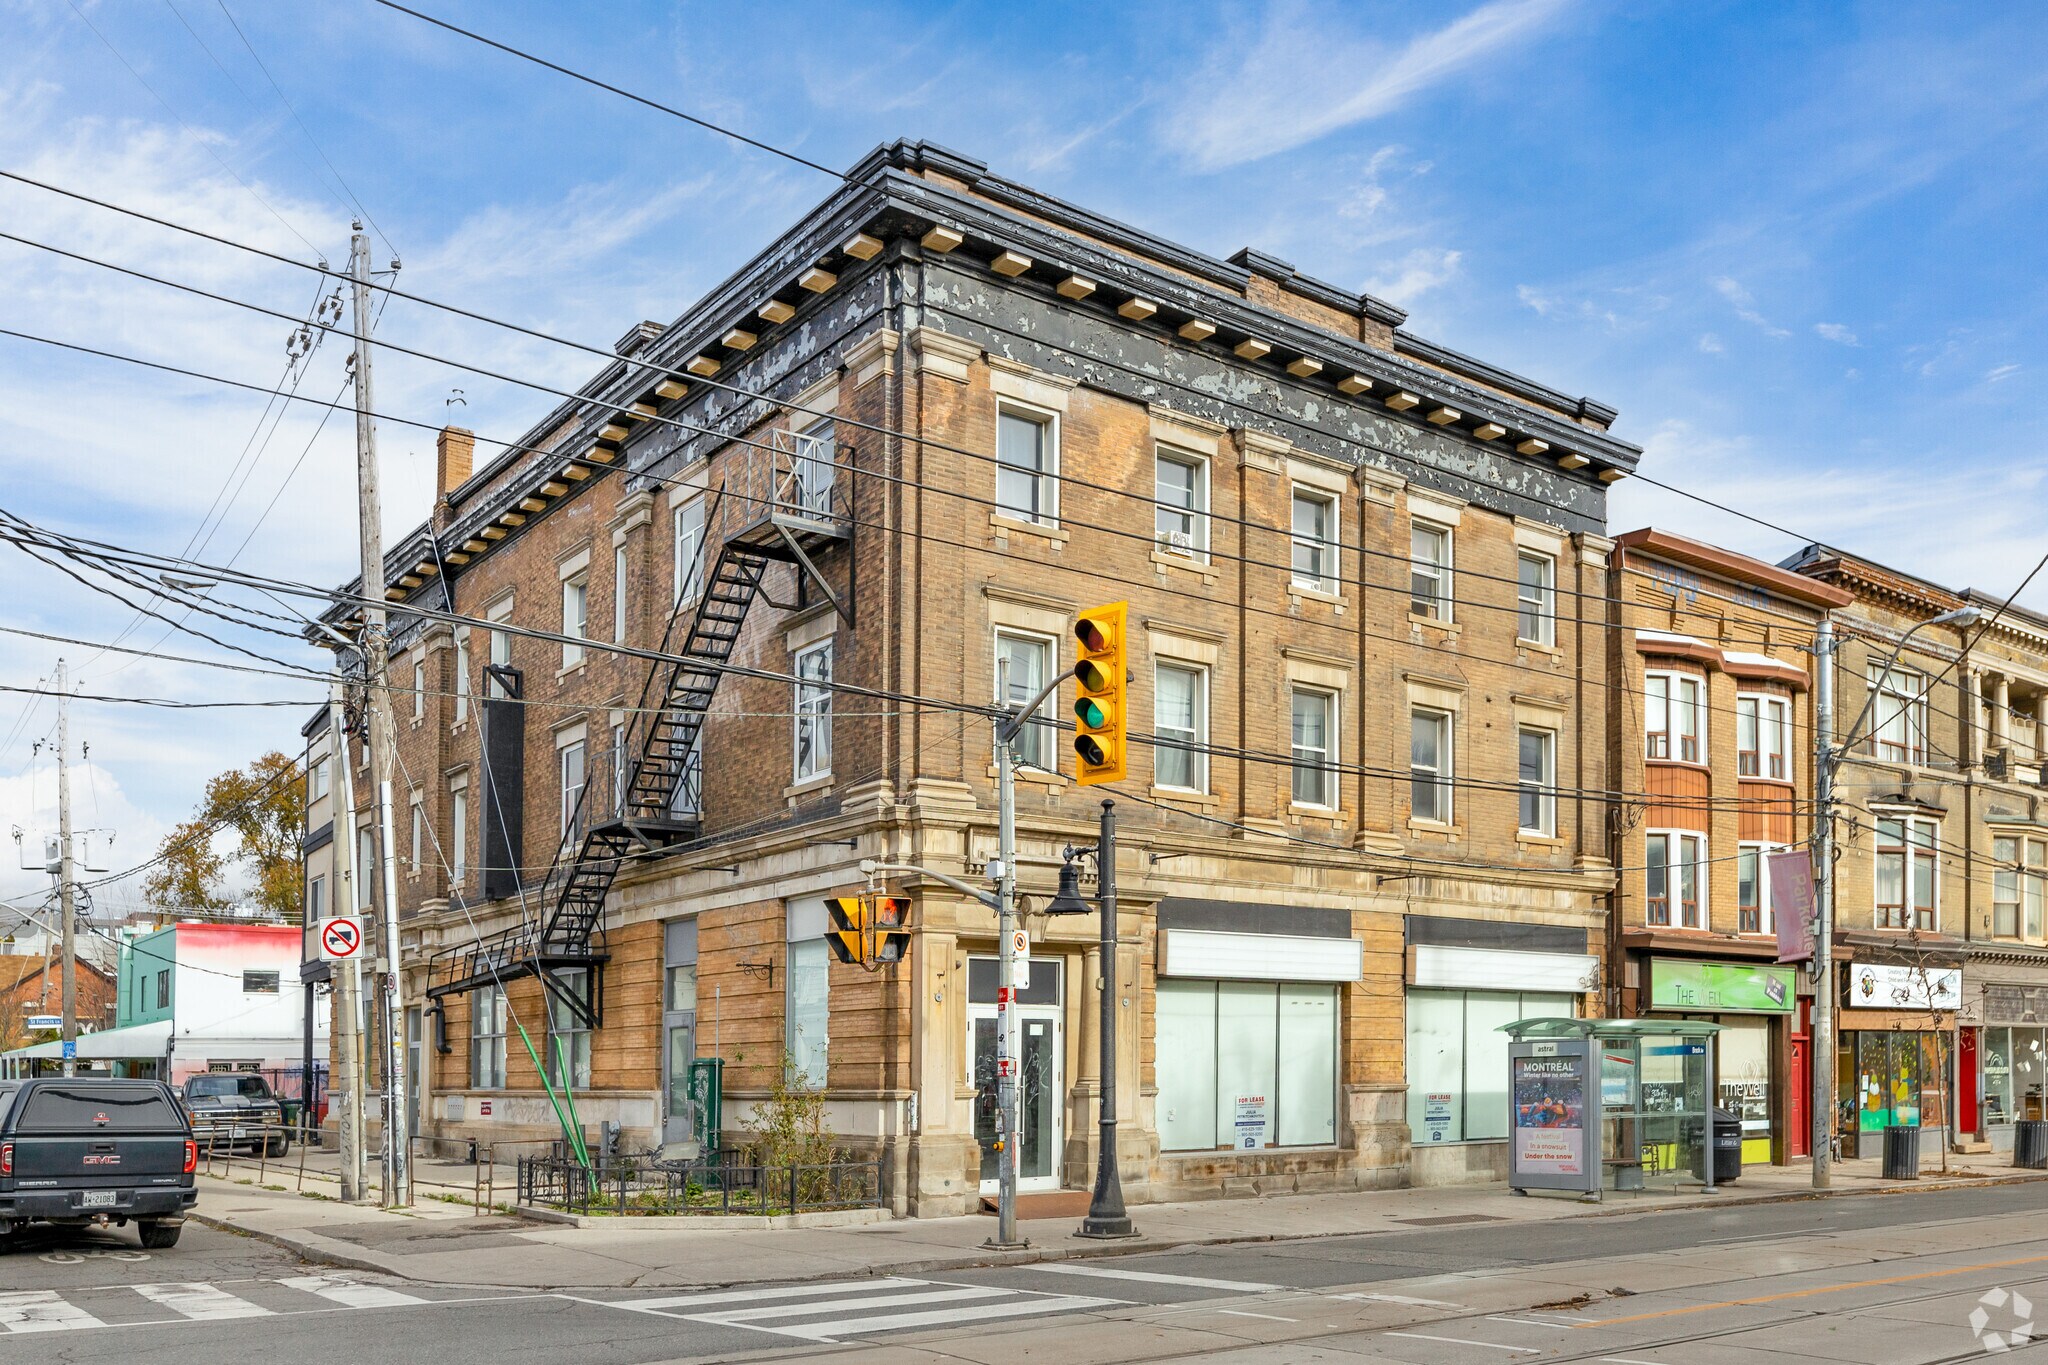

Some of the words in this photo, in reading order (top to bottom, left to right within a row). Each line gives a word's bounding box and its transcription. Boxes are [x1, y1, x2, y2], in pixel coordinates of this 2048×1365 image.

[1675, 984, 1694, 1004] THE
[1537, 1045, 1554, 1053] astral
[1523, 1060, 1575, 1072] MONTRÉAL
[83, 1155, 121, 1165] GMC
